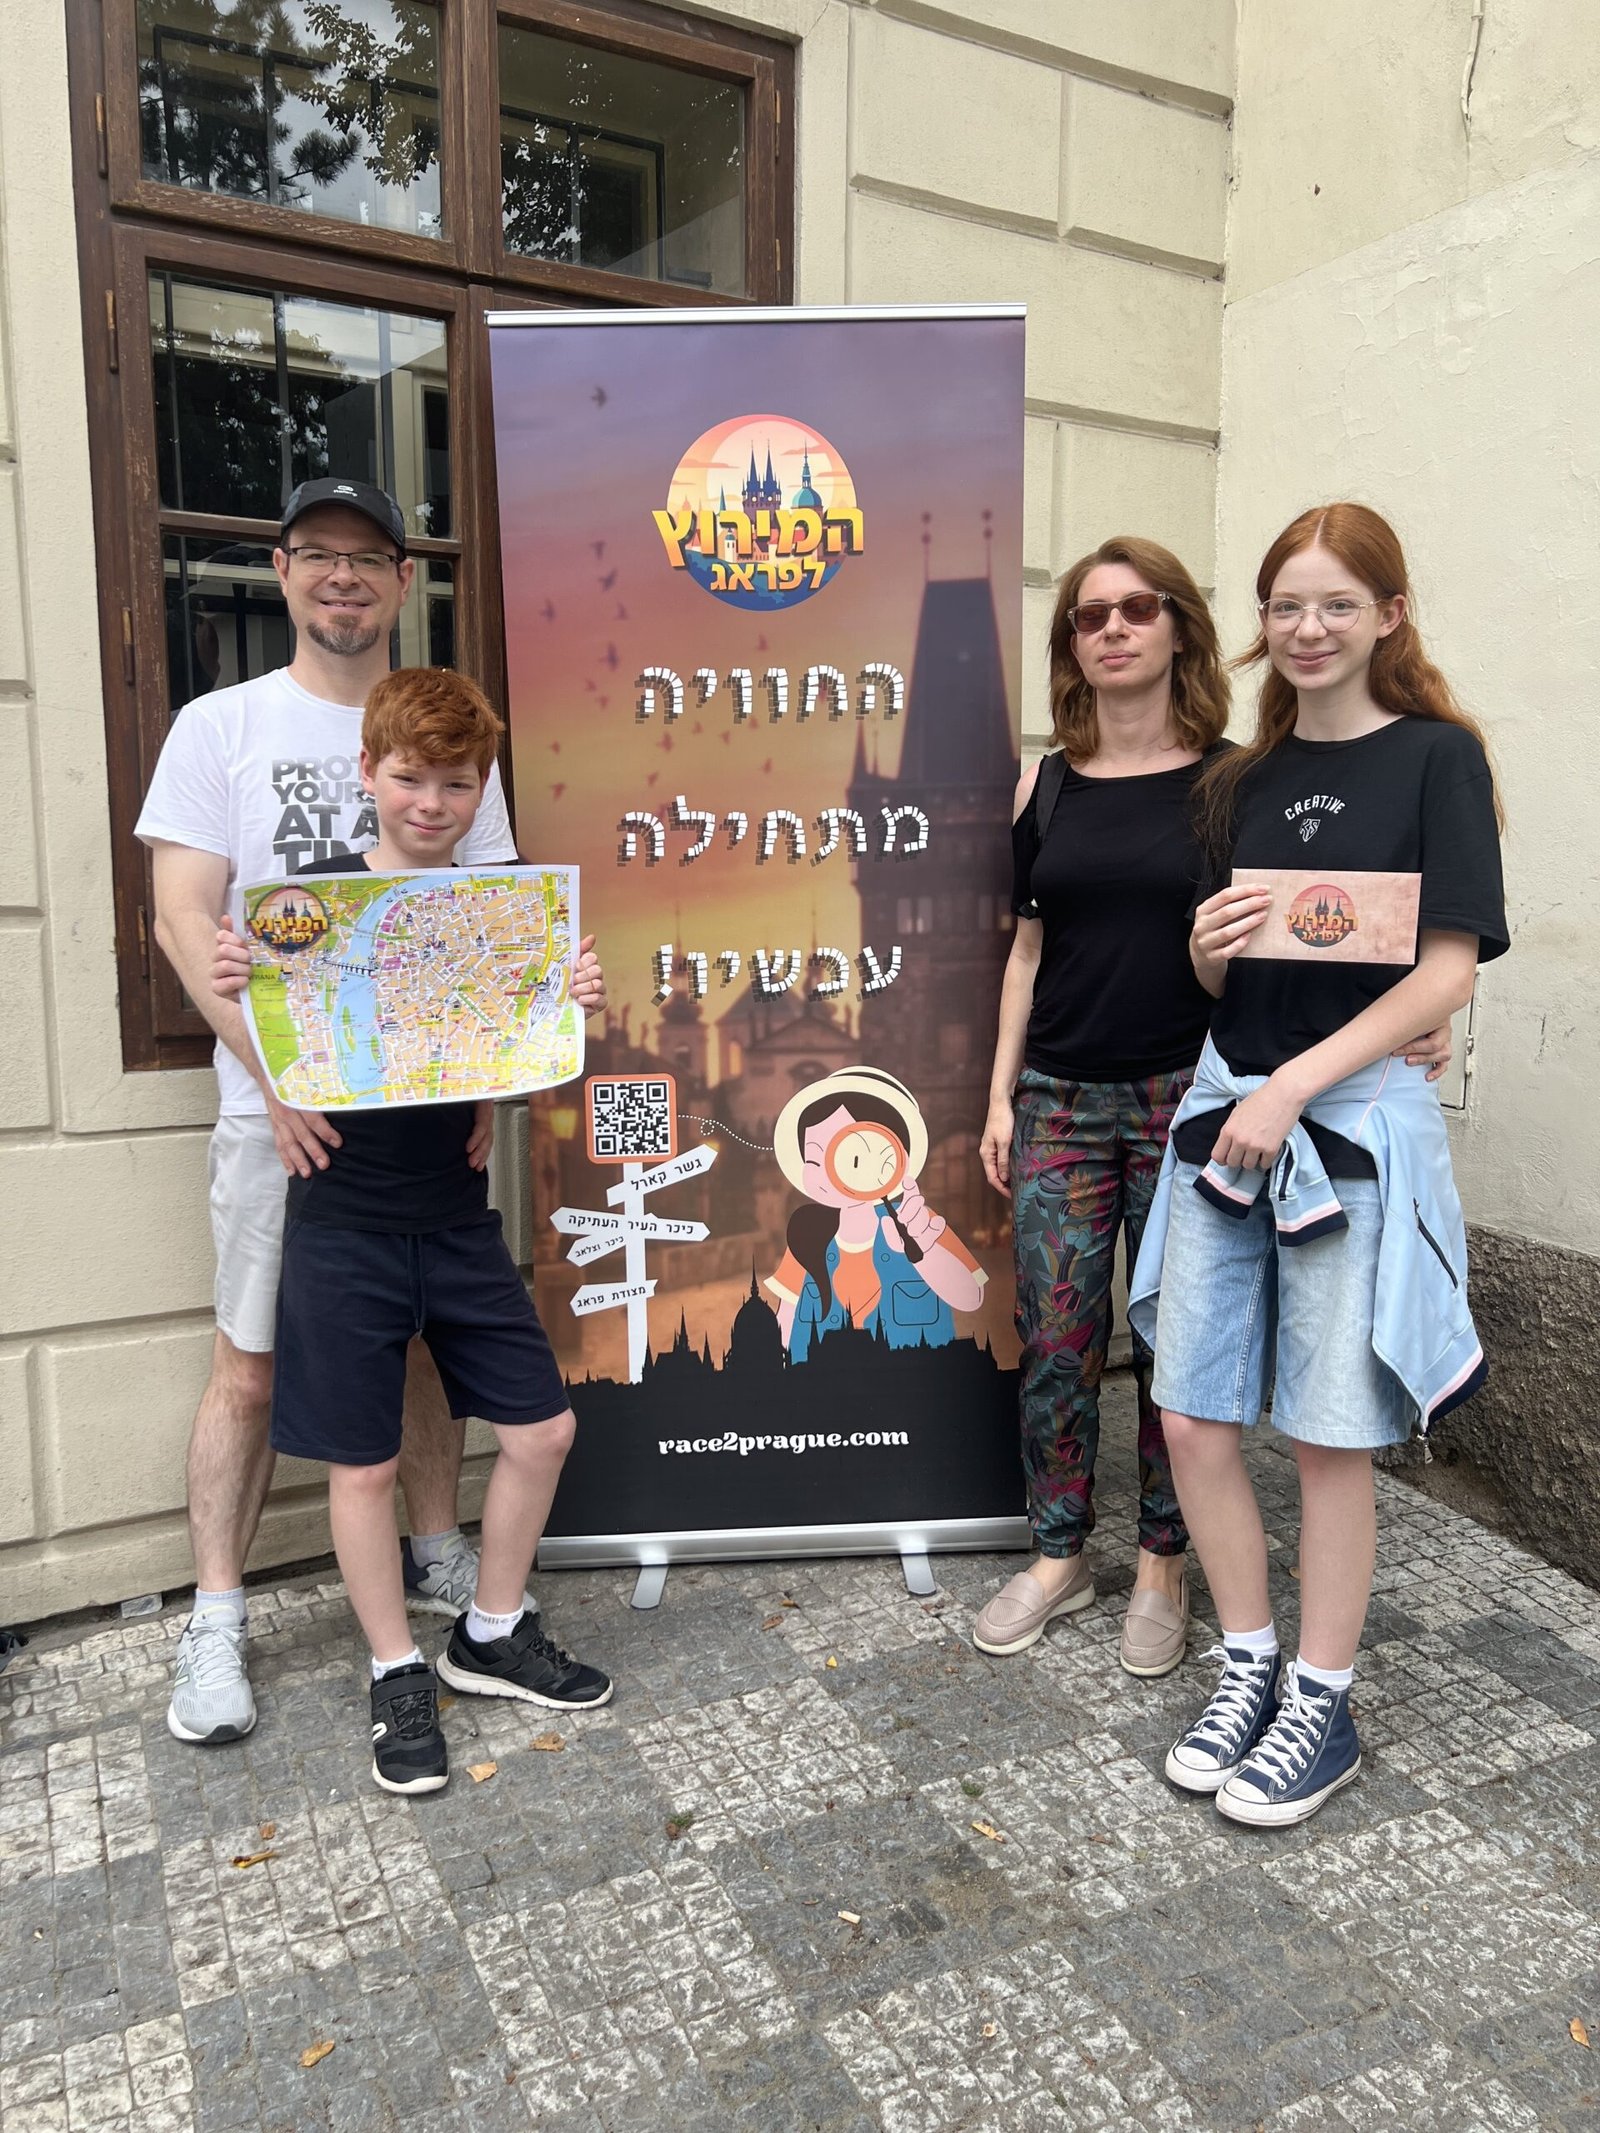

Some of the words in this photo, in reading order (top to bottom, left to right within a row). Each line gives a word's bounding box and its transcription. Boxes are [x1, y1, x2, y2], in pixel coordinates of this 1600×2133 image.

[652, 507, 863, 569] המירוץ
[710, 561, 826, 591] לפראג
[636, 662, 904, 721] החוויה
[272, 755, 361, 782] PROT
[272, 781, 376, 805] YOUR
[1284, 794, 1346, 821] CREATIVE
[273, 804, 341, 842] AT
[619, 795, 930, 864] מתחילה
[251, 915, 329, 937] המירוץ
[1283, 912, 1359, 933] המירוץ
[271, 931, 314, 945] לפראג
[1301, 930, 1344, 941] לפראג
[653, 944, 902, 1004] עכשיו!
[674, 1157, 703, 1175] גשר
[630, 1170, 667, 1191] קארל
[568, 1214, 619, 1229] העתיקה
[628, 1220, 657, 1232] העיר
[666, 1222, 694, 1235] כיכר
[575, 1243, 601, 1257] וצלאב
[605, 1235, 624, 1247] כיכר
[577, 1294, 605, 1308] פראג
[612, 1286, 646, 1300] מצודת
[658, 1431, 909, 1456] race2prague.com
